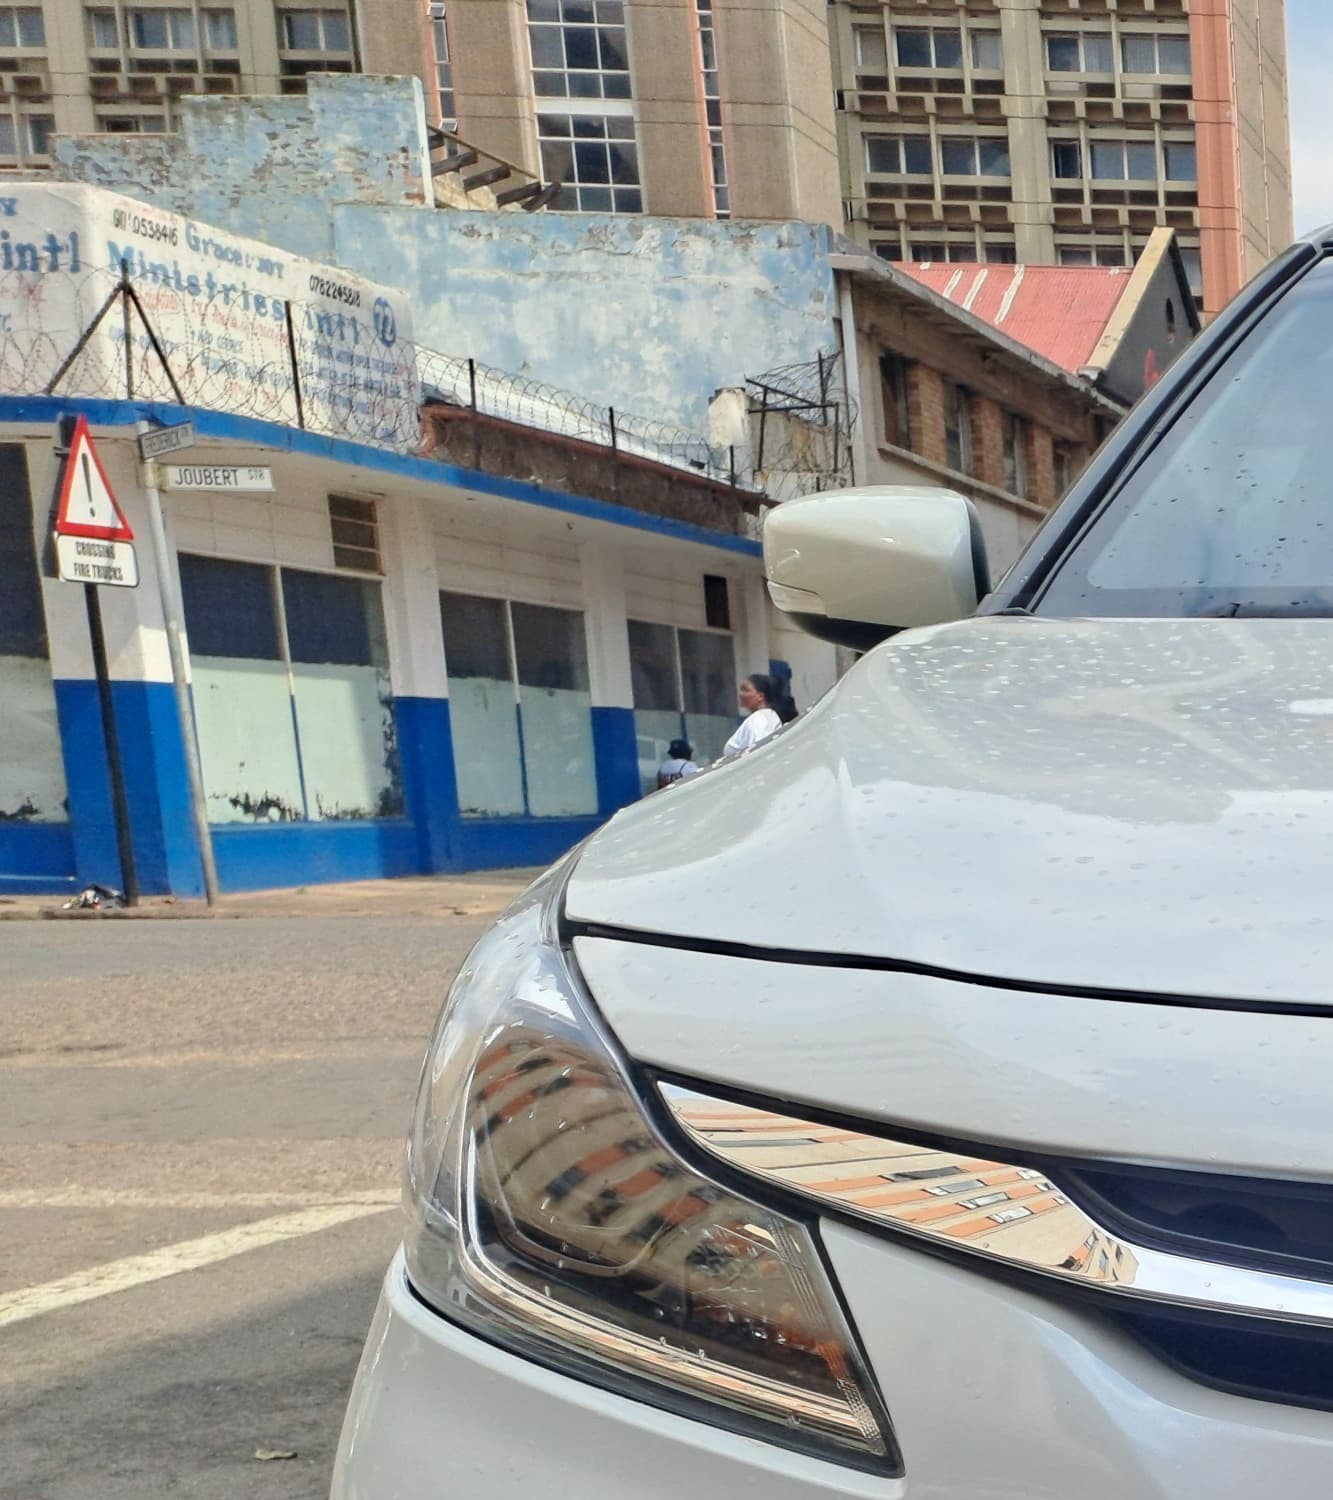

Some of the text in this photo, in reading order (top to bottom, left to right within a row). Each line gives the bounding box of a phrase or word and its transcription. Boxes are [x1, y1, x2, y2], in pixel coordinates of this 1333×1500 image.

[107, 239, 286, 322] Ministries
[175, 468, 265, 486] JOUBERT STR
[75, 541, 116, 559] CROSSING
[74, 562, 123, 581] FIRE TRUCKS
